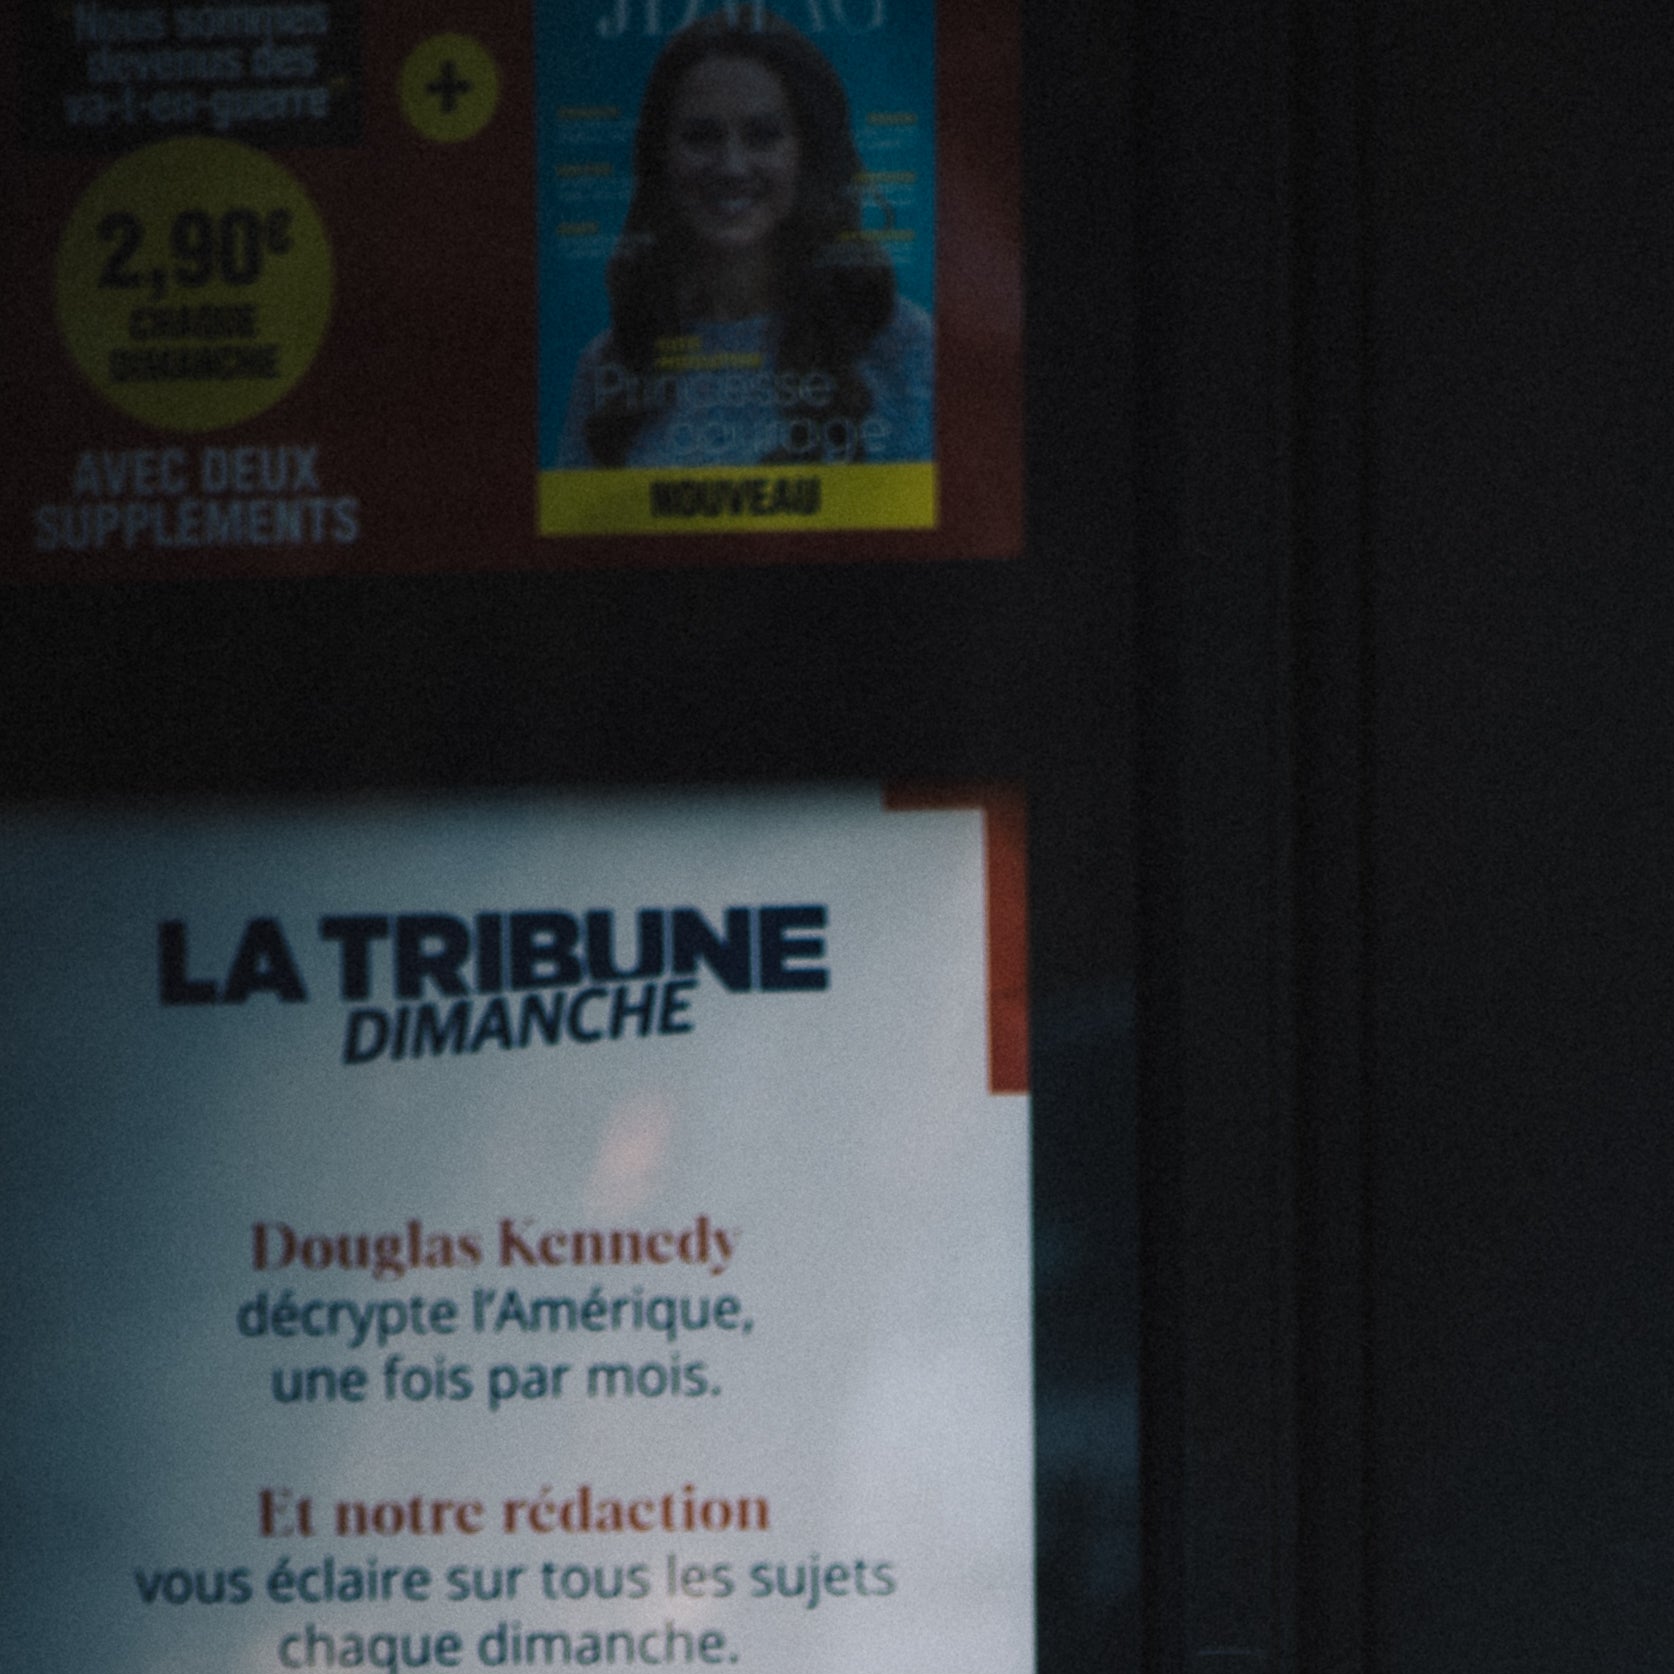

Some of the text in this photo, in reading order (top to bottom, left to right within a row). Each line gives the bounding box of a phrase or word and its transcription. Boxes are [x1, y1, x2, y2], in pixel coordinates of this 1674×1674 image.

[108, 345, 281, 383] DIMANCHE
[593, 361, 838, 412] Princesse
[666, 411, 892, 464] courage
[72, 445, 321, 498] AVEC DEUX
[650, 477, 823, 520] NOUVEAU
[158, 904, 830, 1006] LA TRIBUNE
[342, 978, 699, 1066] DIMANCHE
[250, 1215, 740, 1283] Douglas Kennedy
[236, 1284, 755, 1350] décrypte l'Amérique,
[271, 1351, 722, 1413] une fois par mois.
[257, 1484, 771, 1538] Et notre rédaction
[133, 1552, 896, 1612] vous éclaire sur tous les sujets
[478, 1619, 740, 1668] dimanche.
